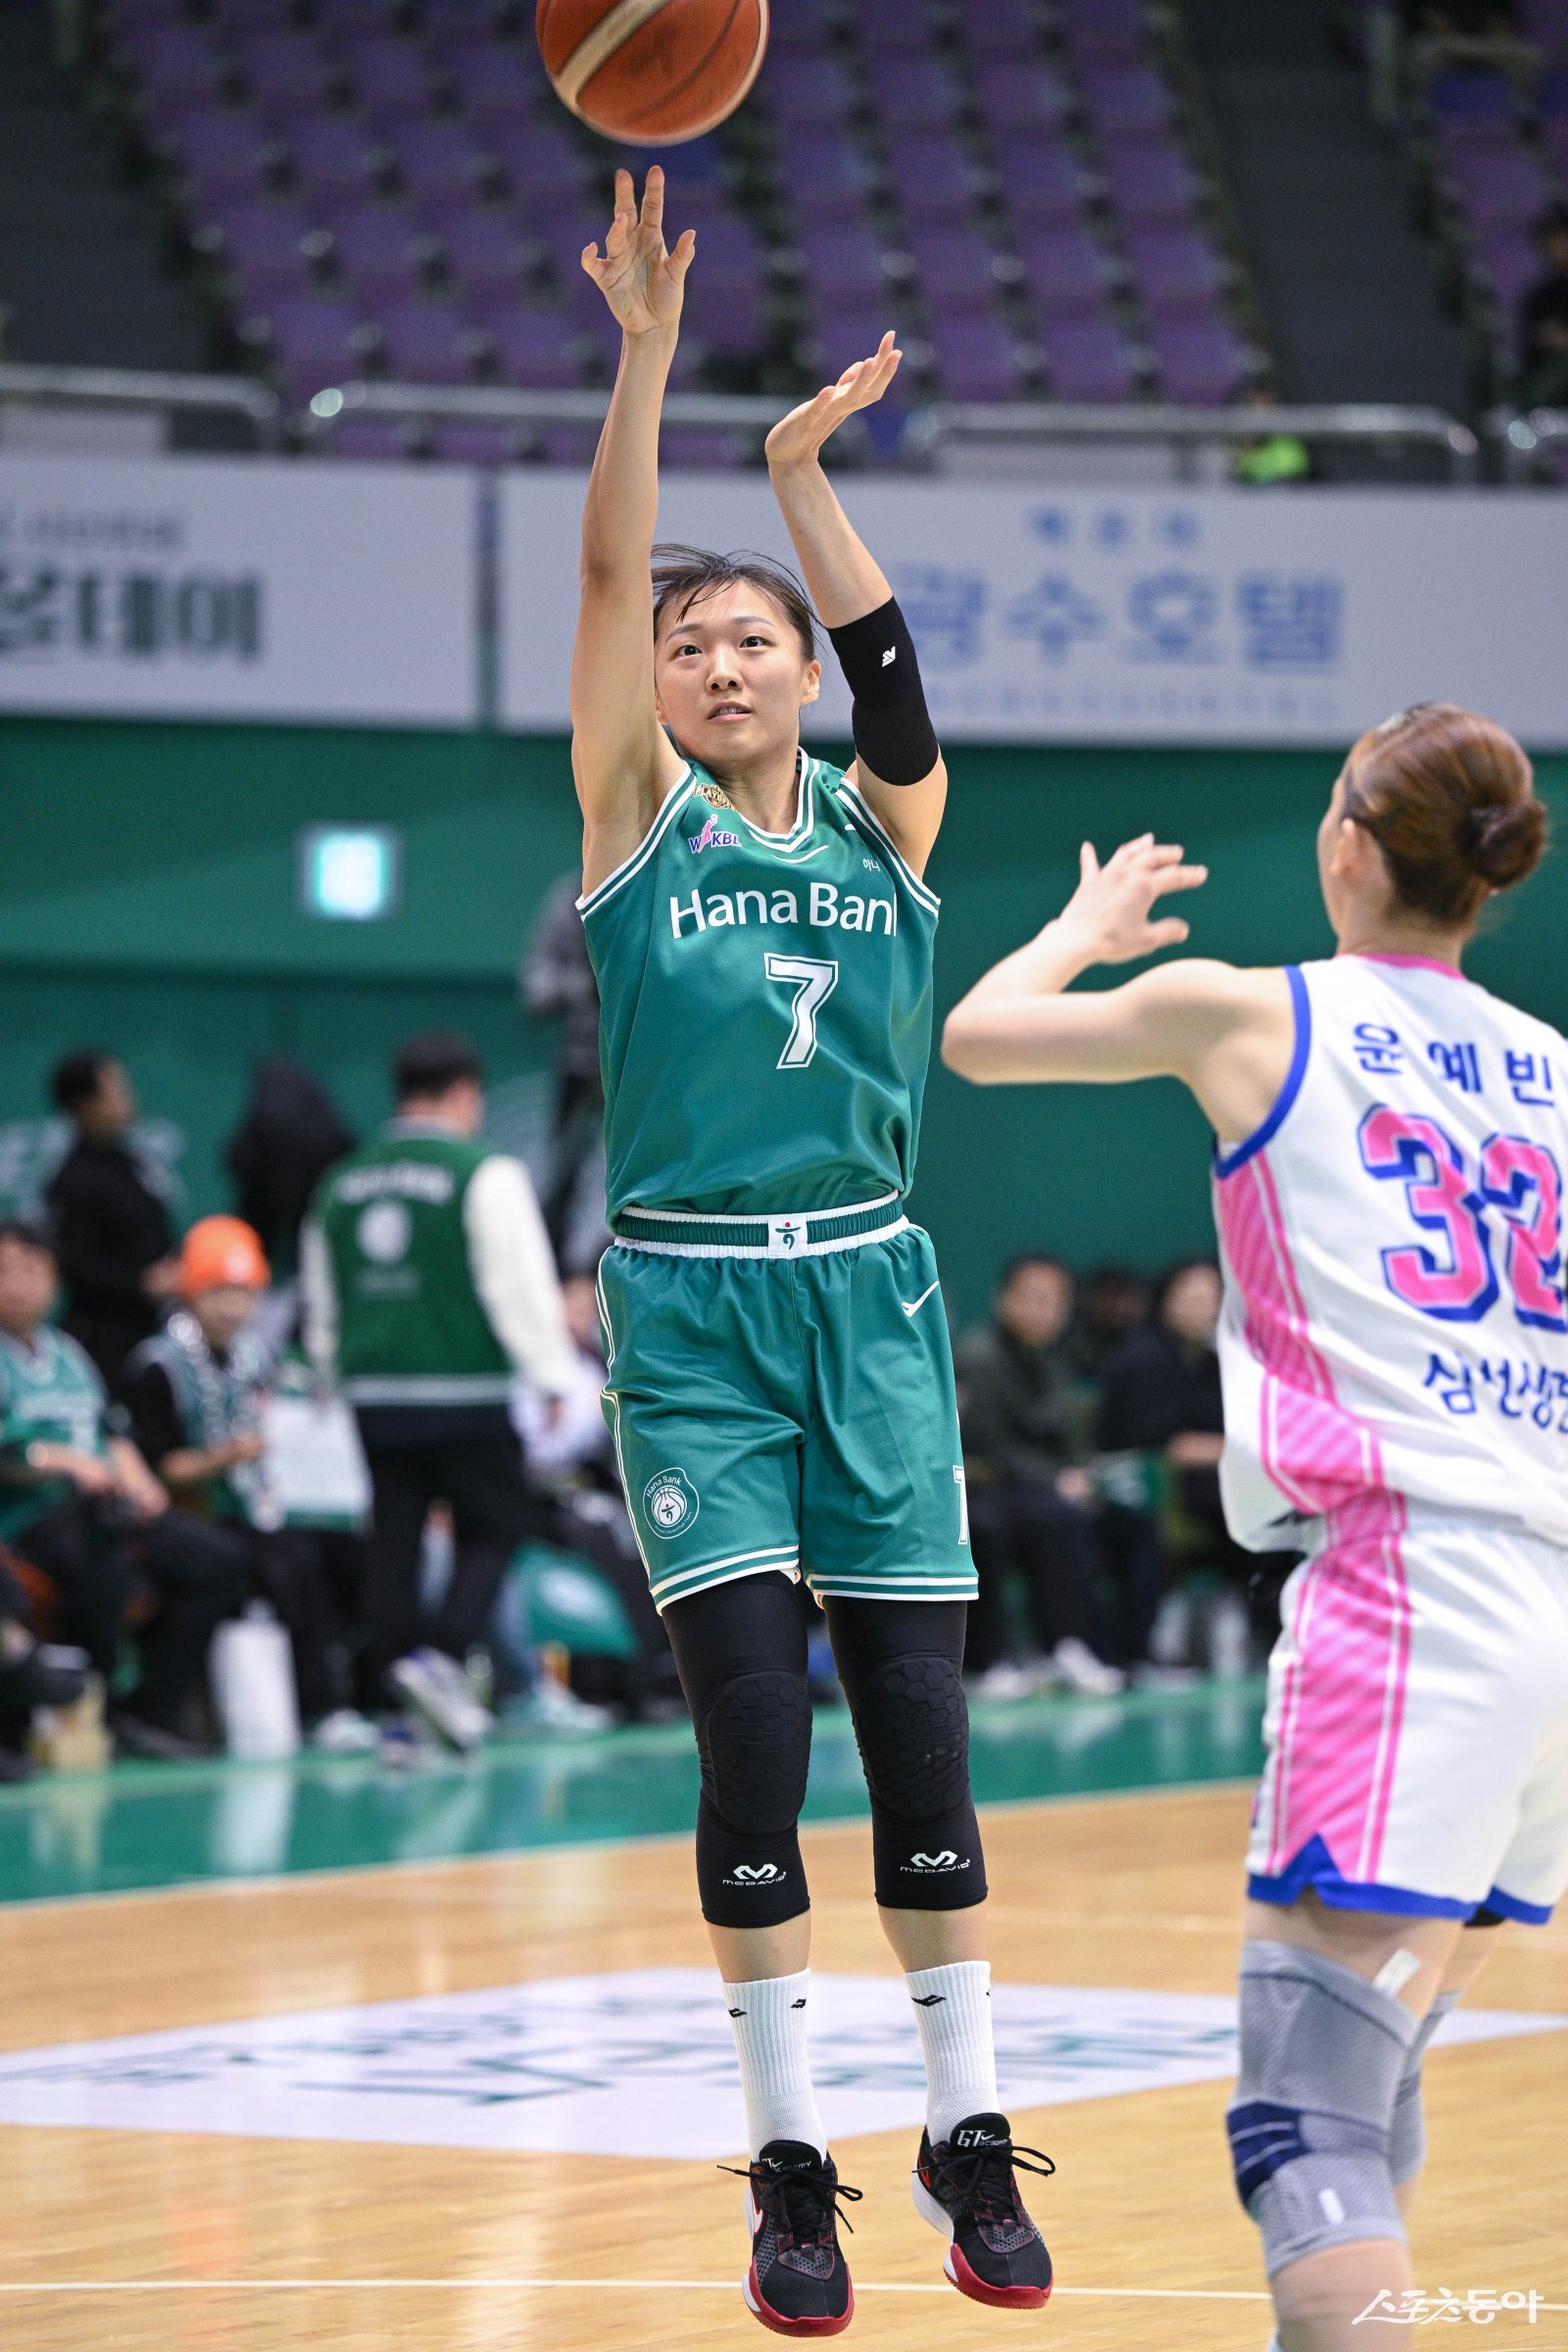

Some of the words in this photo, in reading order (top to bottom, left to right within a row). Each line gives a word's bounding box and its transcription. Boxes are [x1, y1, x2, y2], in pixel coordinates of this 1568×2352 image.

[670, 886, 799, 939] Hana
[763, 952, 839, 1070] 7
[1356, 1102, 1568, 1333] 32
[646, 1479, 663, 1498] Hana
[662, 1475, 682, 1487] Bank
[956, 2130, 986, 2148] GT
